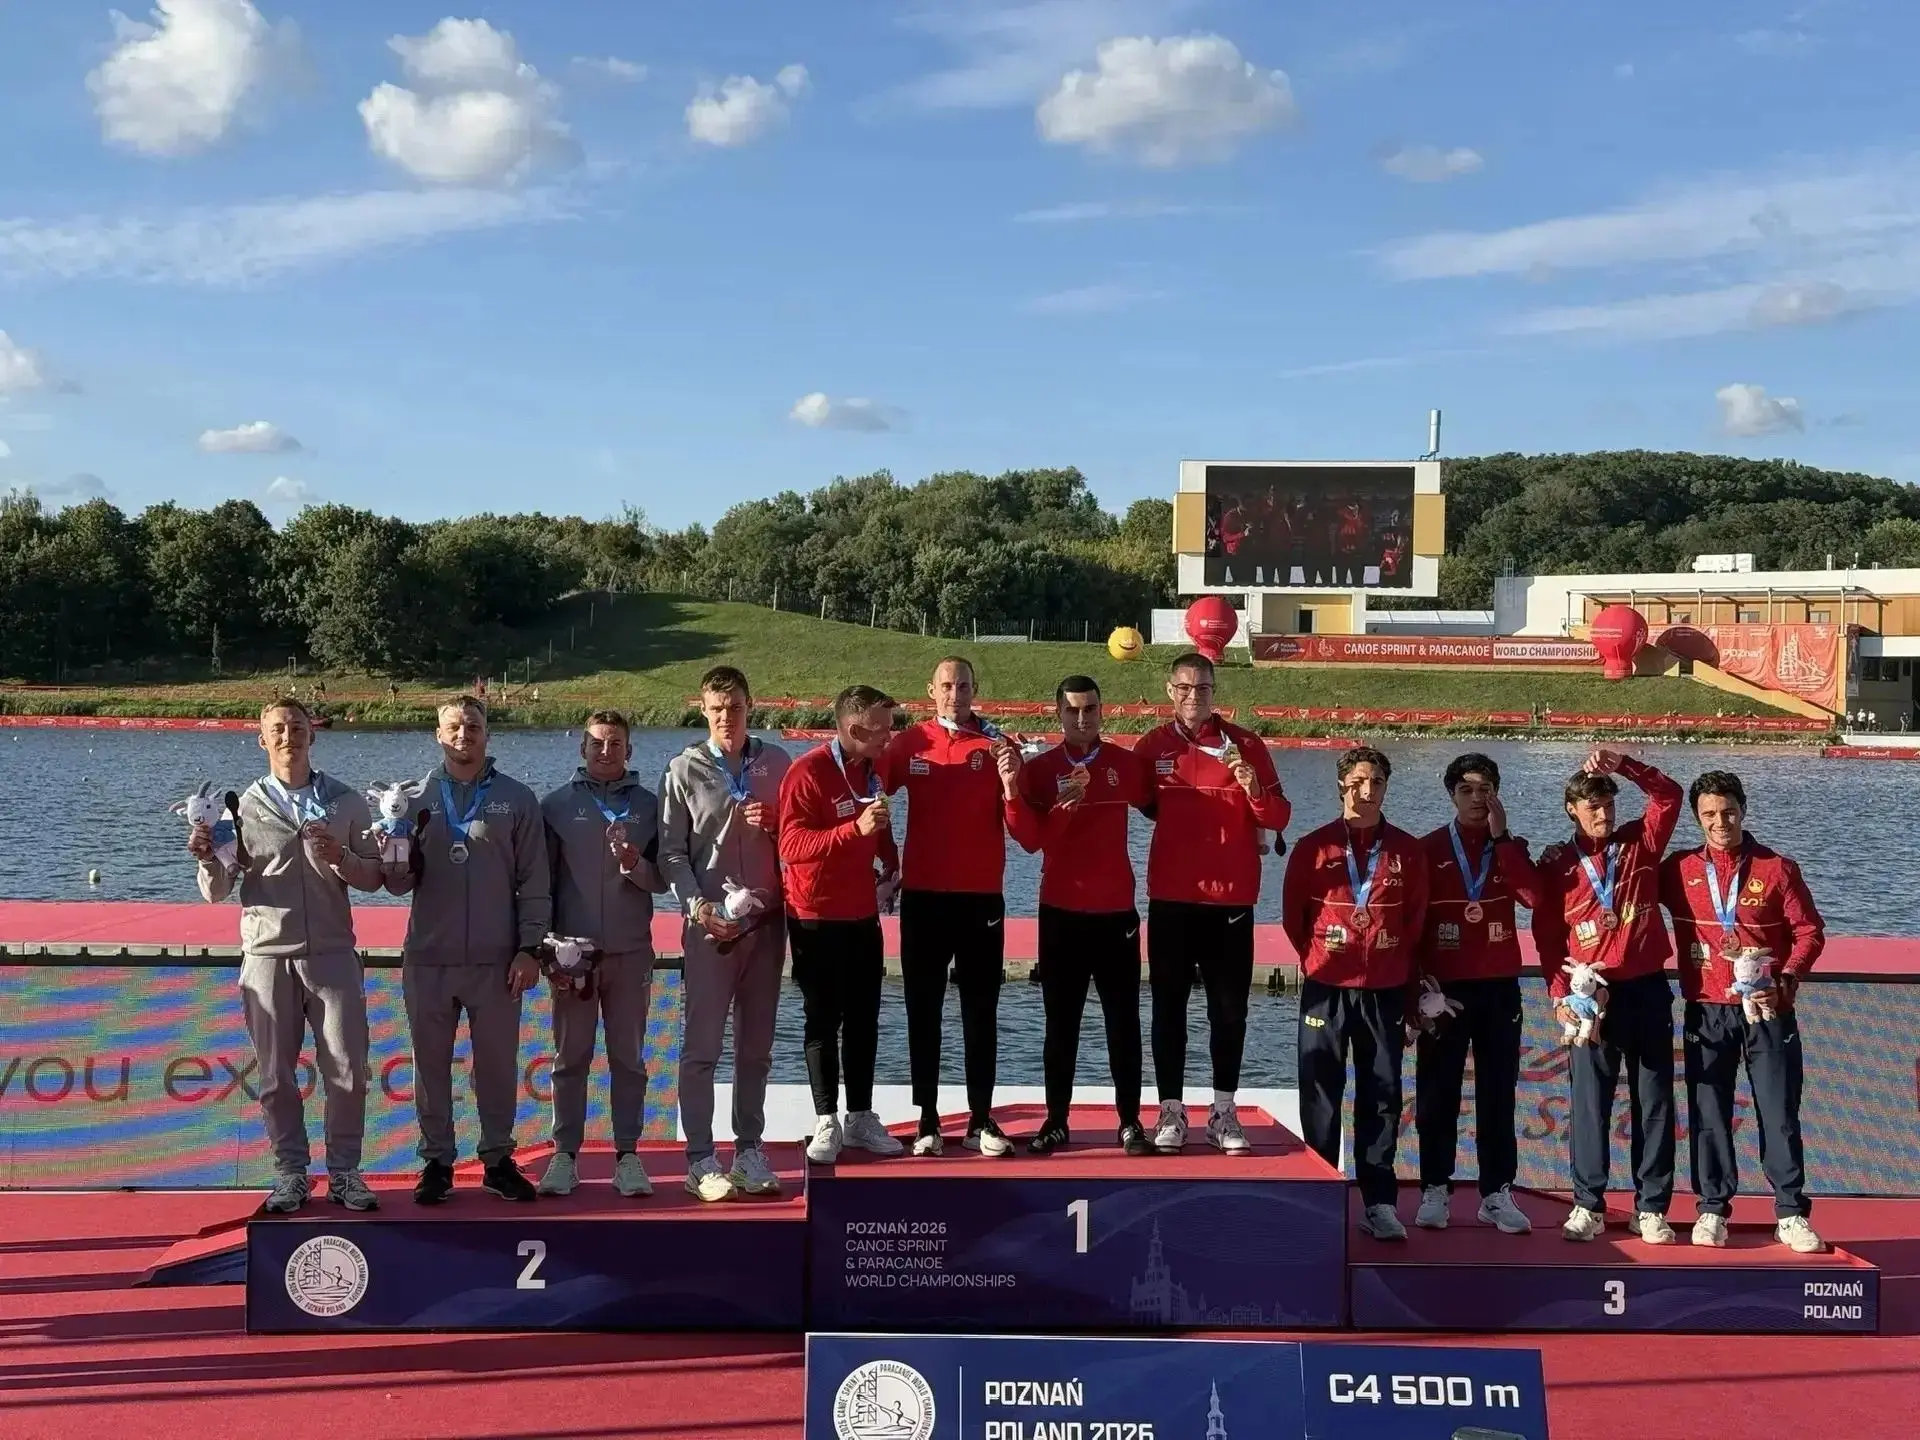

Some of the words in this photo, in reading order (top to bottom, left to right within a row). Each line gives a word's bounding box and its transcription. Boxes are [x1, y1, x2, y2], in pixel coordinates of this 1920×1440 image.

[1344, 643, 1378, 655] CANOE
[1380, 643, 1417, 655] SPRINT
[1418, 645, 1426, 656] &
[1429, 645, 1490, 656] PARACANOE
[1495, 646, 1527, 657] WORLD
[846, 1218, 907, 1234] POZNAŃ
[911, 1221, 947, 1234] 2026
[1067, 1199, 1089, 1254] 1
[845, 1239, 895, 1252] CANOE
[897, 1239, 948, 1252] SPRINT
[516, 1240, 546, 1290] 2
[845, 1257, 856, 1270] &
[858, 1257, 943, 1270] PARACANOE
[845, 1274, 897, 1288] WORLD
[899, 1274, 1016, 1288] CHAMPIONSHIPS
[1804, 1280, 1863, 1297] POZNAŃ
[1603, 1280, 1625, 1315] 3
[1804, 1304, 1862, 1319] POLAND
[842, 1376, 860, 1396] SPRINT
[880, 1363, 914, 1380] PARACANOE
[911, 1376, 929, 1397] WORLD
[985, 1377, 1083, 1406] POZNAŃ
[1329, 1373, 1382, 1404] C4
[1391, 1375, 1473, 1407] 500
[1484, 1384, 1520, 1408] m
[985, 1421, 1083, 1440] POLAND
[1090, 1422, 1154, 1440] 2026
